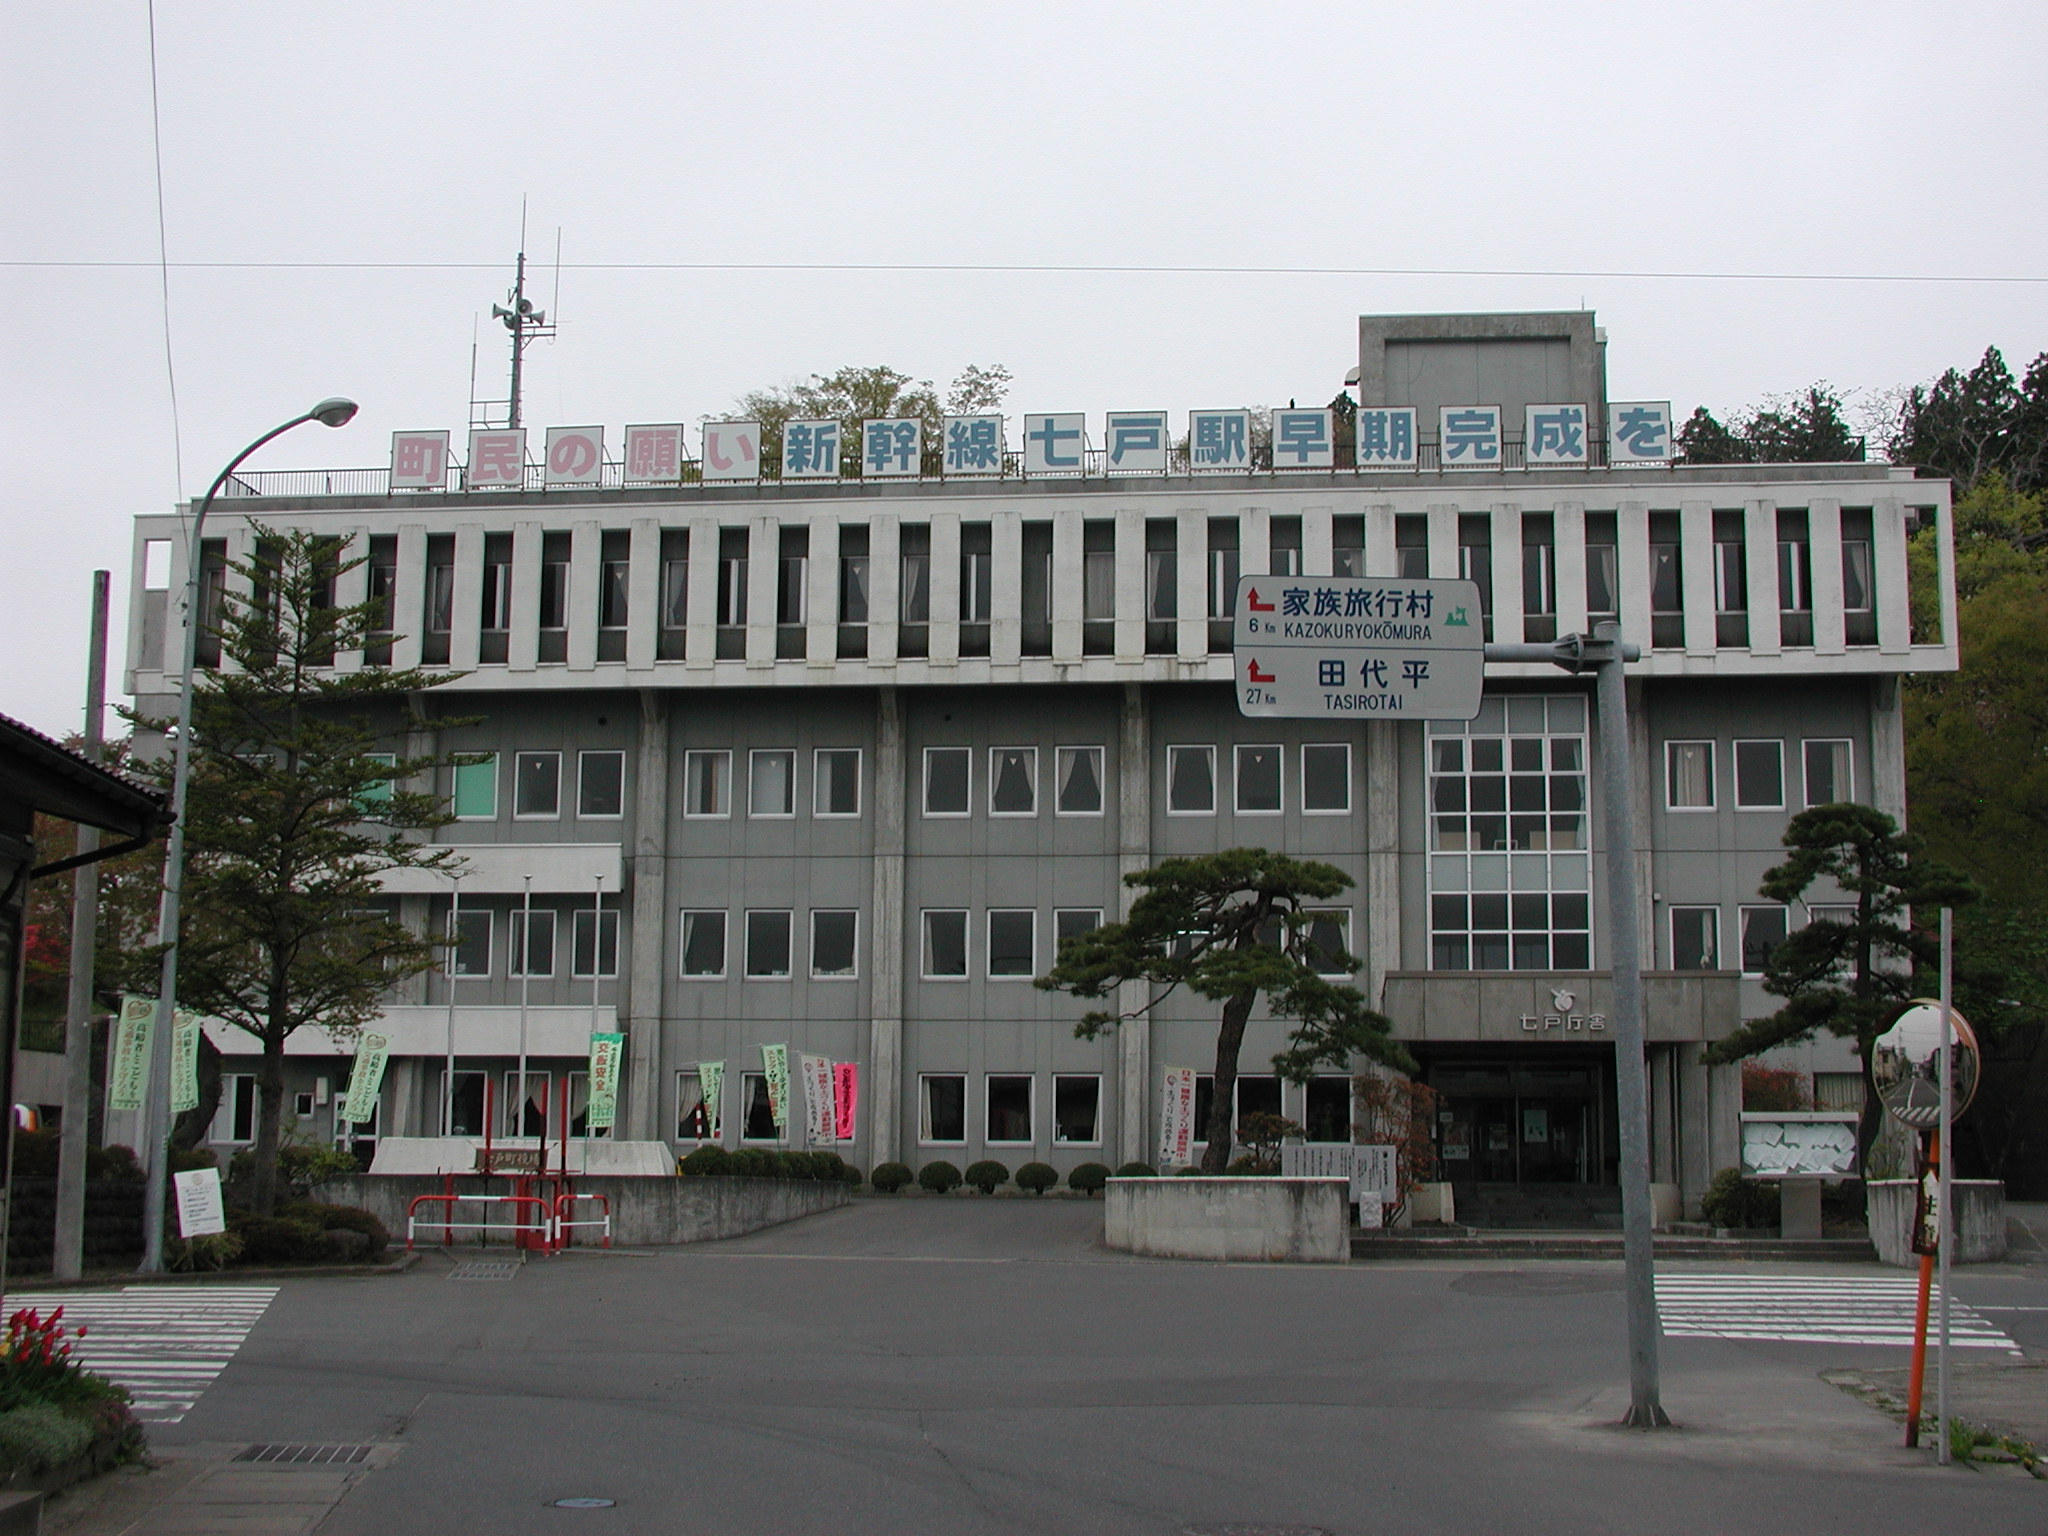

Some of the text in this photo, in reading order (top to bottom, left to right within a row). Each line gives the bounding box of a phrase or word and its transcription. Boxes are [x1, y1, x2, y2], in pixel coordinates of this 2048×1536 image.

[1282, 587, 1434, 619] 家族旅行村
[1249, 618, 1258, 632] 6
[1319, 659, 1430, 689] 田代平
[1246, 689, 1261, 704] 27
[1324, 694, 1402, 710] TASIROTAI
[1520, 1013, 1606, 1030] 七戸庁舎
[595, 1043, 609, 1091] 交通安全
